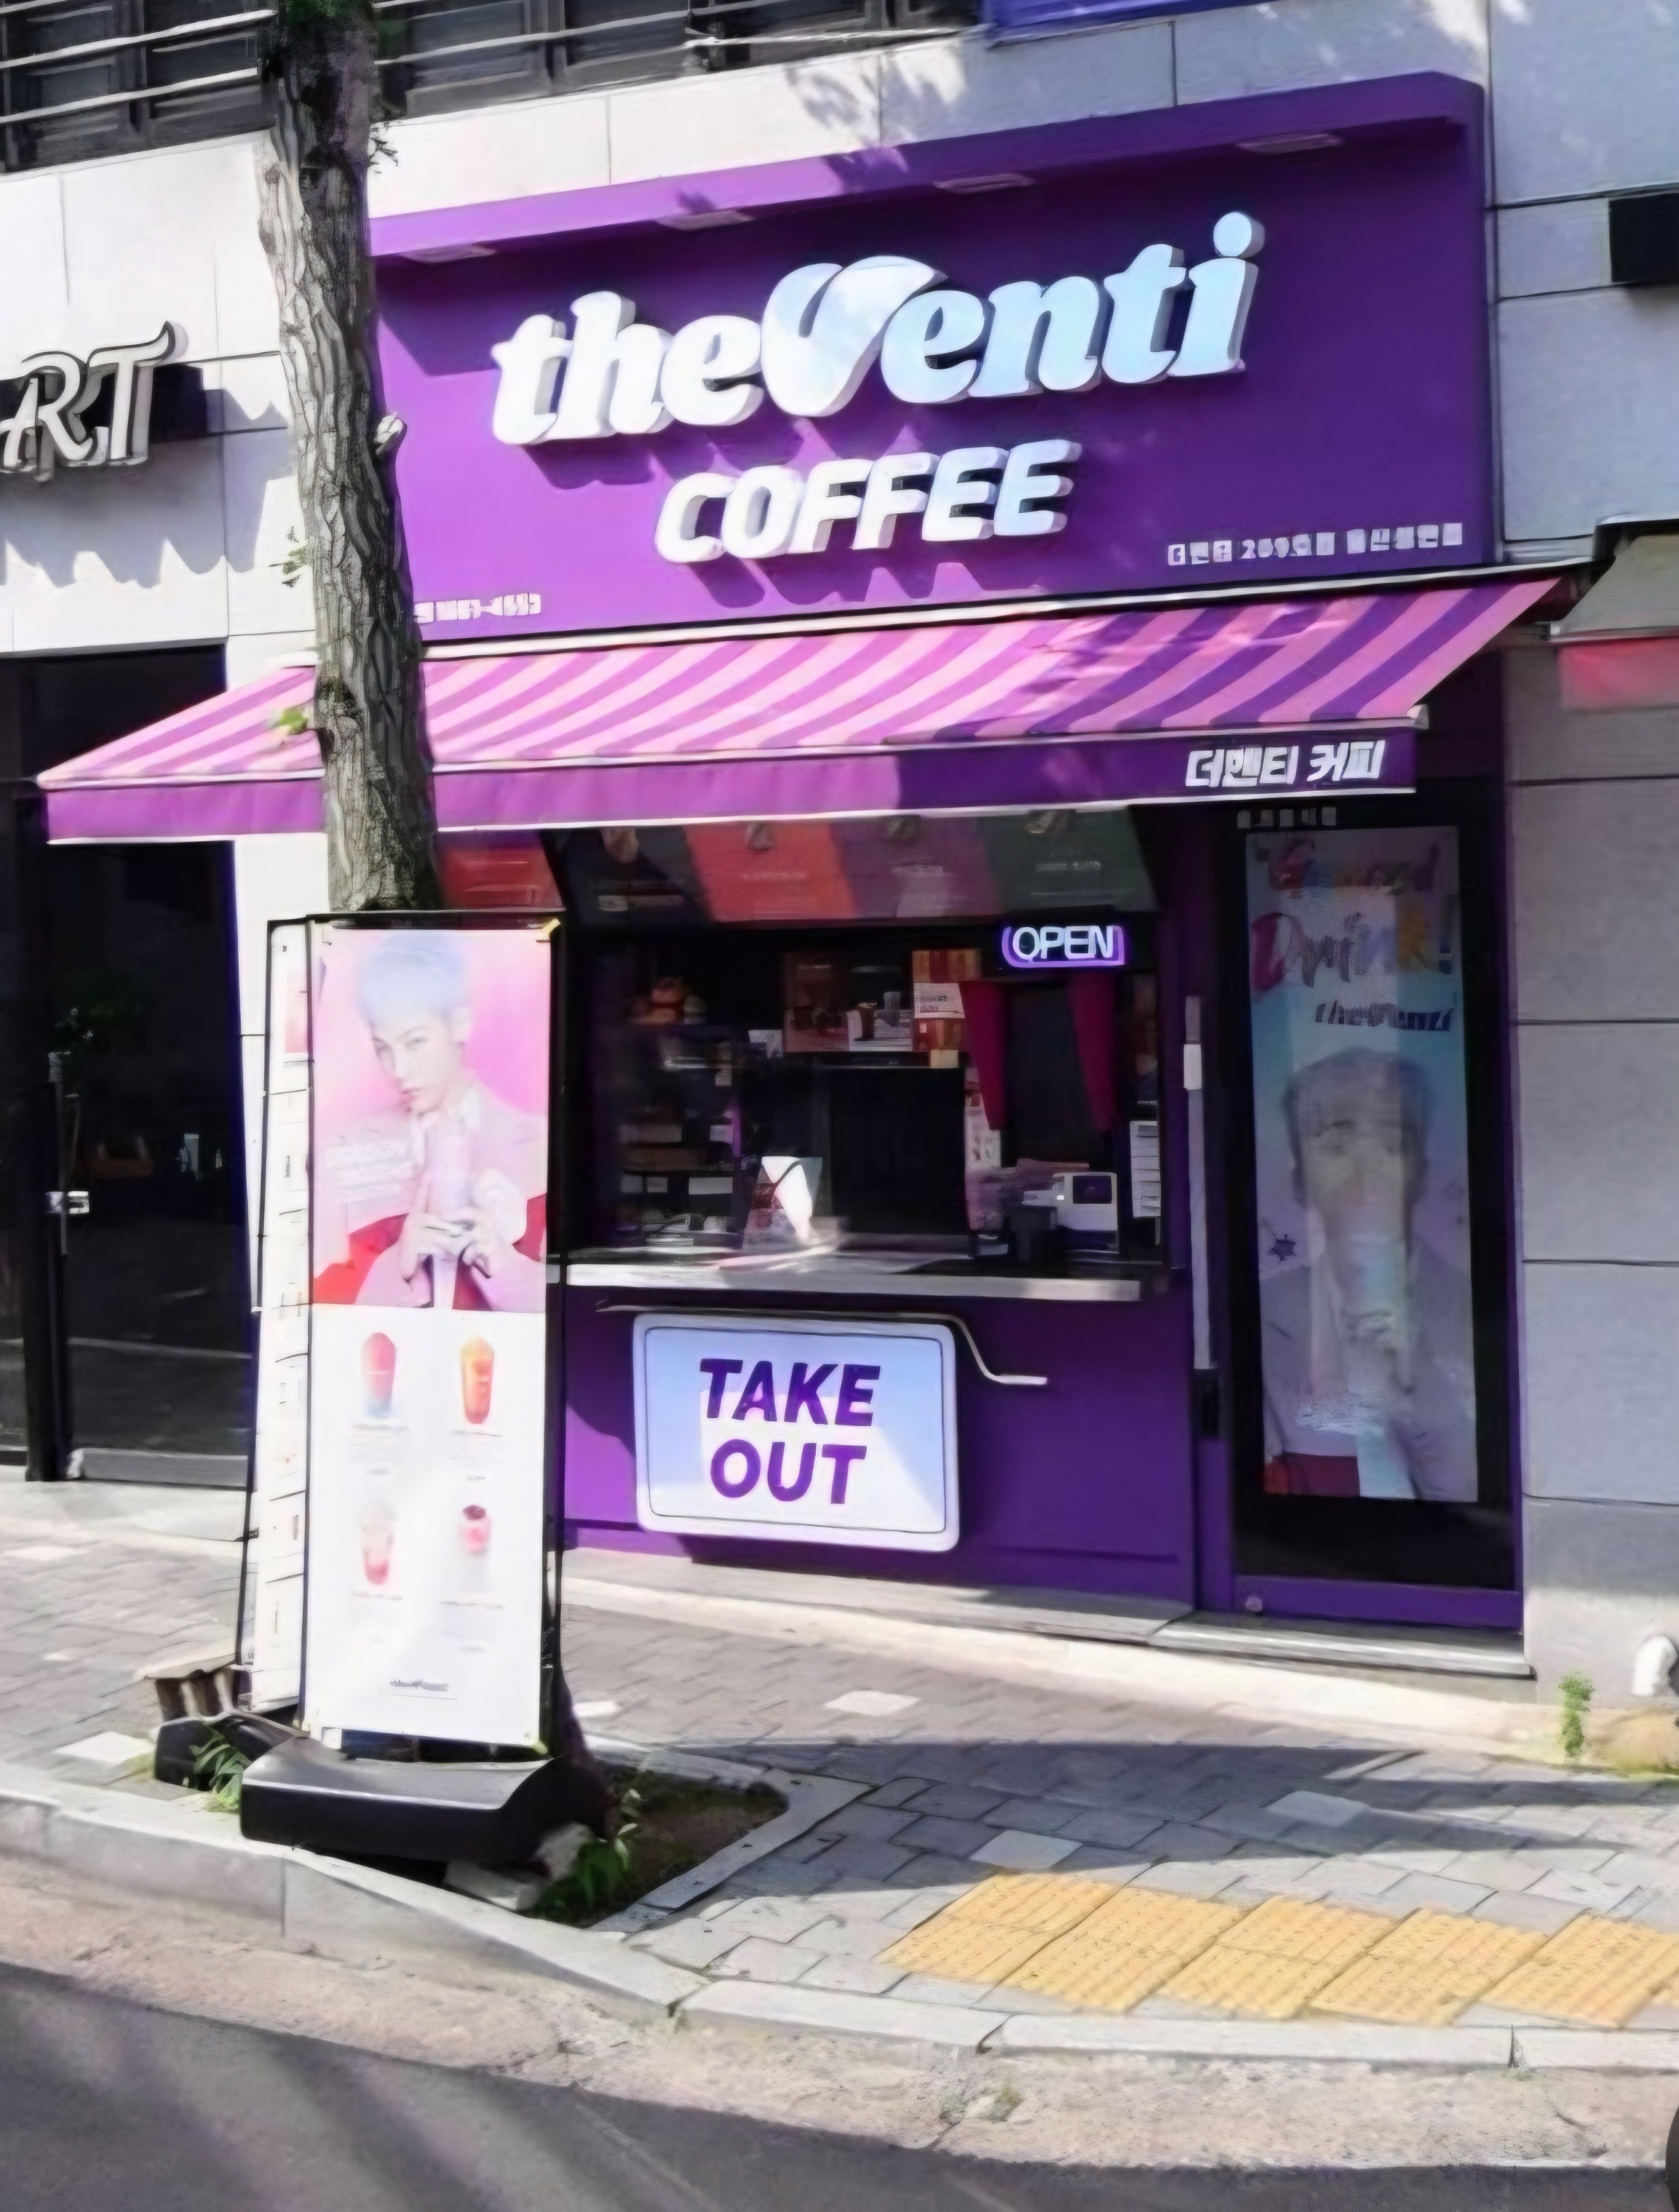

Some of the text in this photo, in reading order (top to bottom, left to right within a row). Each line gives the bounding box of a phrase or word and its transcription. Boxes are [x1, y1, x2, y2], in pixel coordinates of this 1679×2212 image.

[654, 439, 1083, 562] COFFEE
[1306, 739, 1386, 782] 커피
[1012, 925, 1114, 960] OPEN
[699, 1358, 881, 1427] TAKE
[708, 1438, 868, 1505] OUT
